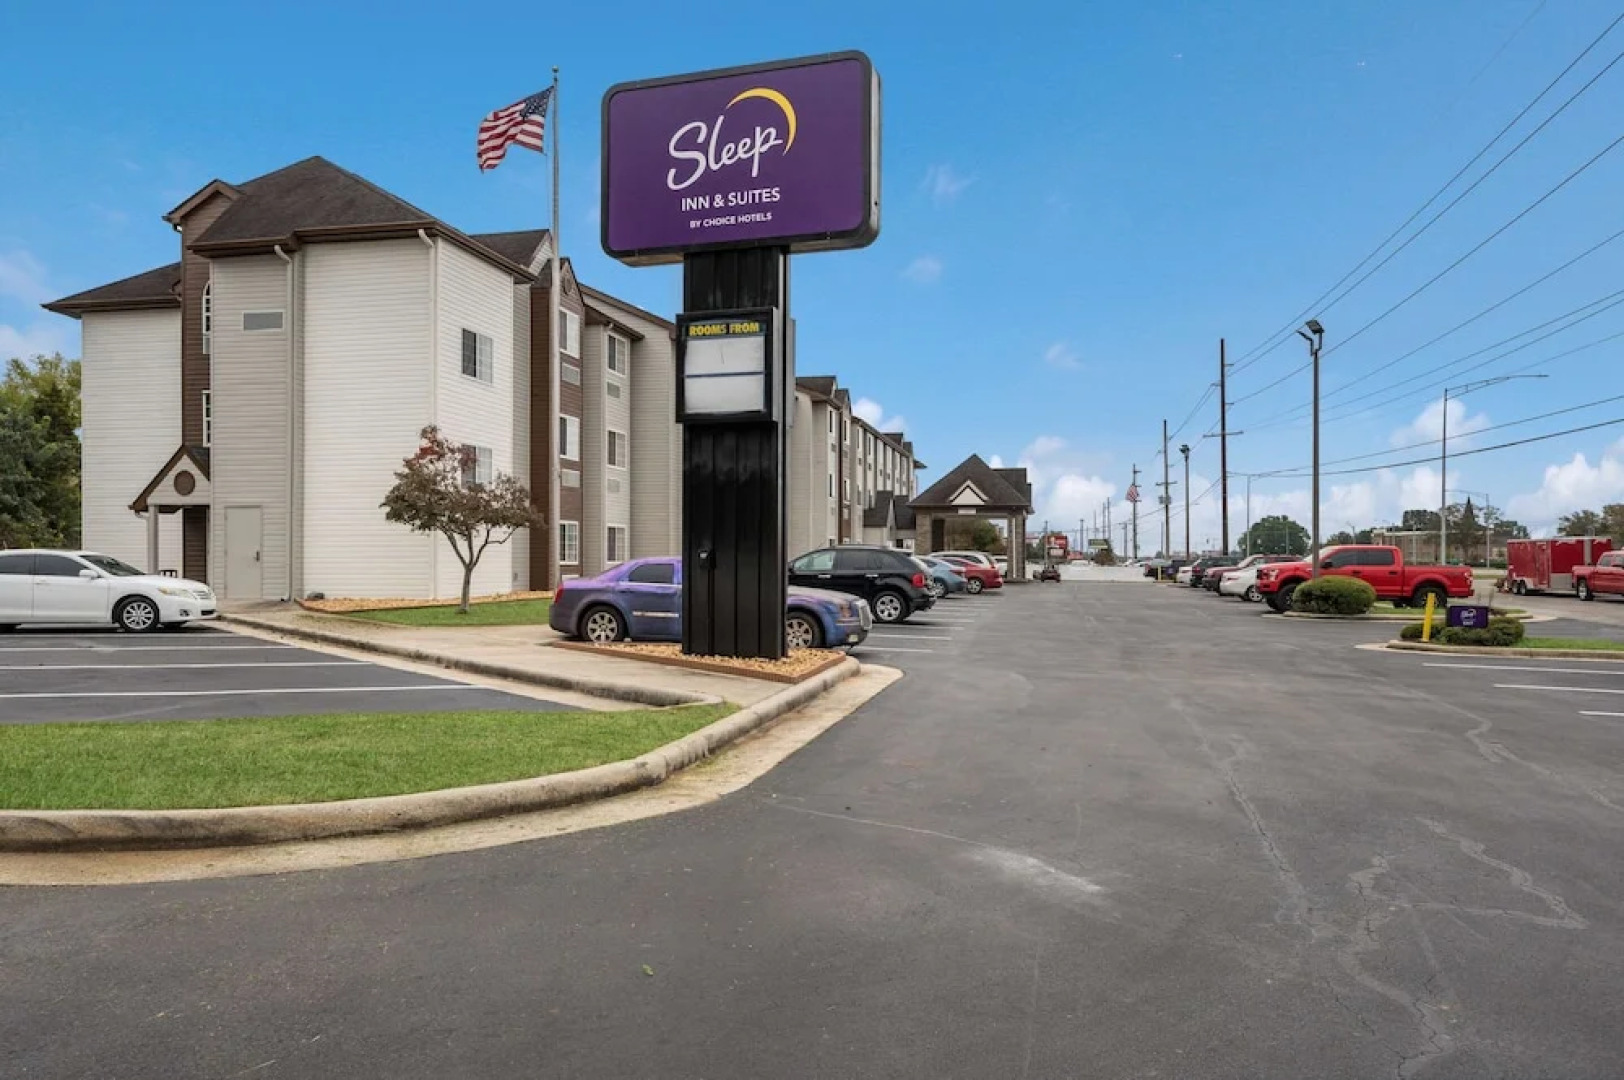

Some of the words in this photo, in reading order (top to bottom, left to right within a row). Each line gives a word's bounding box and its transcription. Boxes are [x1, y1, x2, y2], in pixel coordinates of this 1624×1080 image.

[666, 114, 783, 191] Sleep
[681, 196, 709, 212] INN
[713, 194, 725, 208] &
[728, 187, 781, 206] SUITES
[689, 220, 702, 229] BY
[703, 216, 736, 227] CHOICE
[738, 212, 773, 223] HOTELS
[690, 324, 727, 337] ROOMS
[729, 322, 759, 334] FROM
